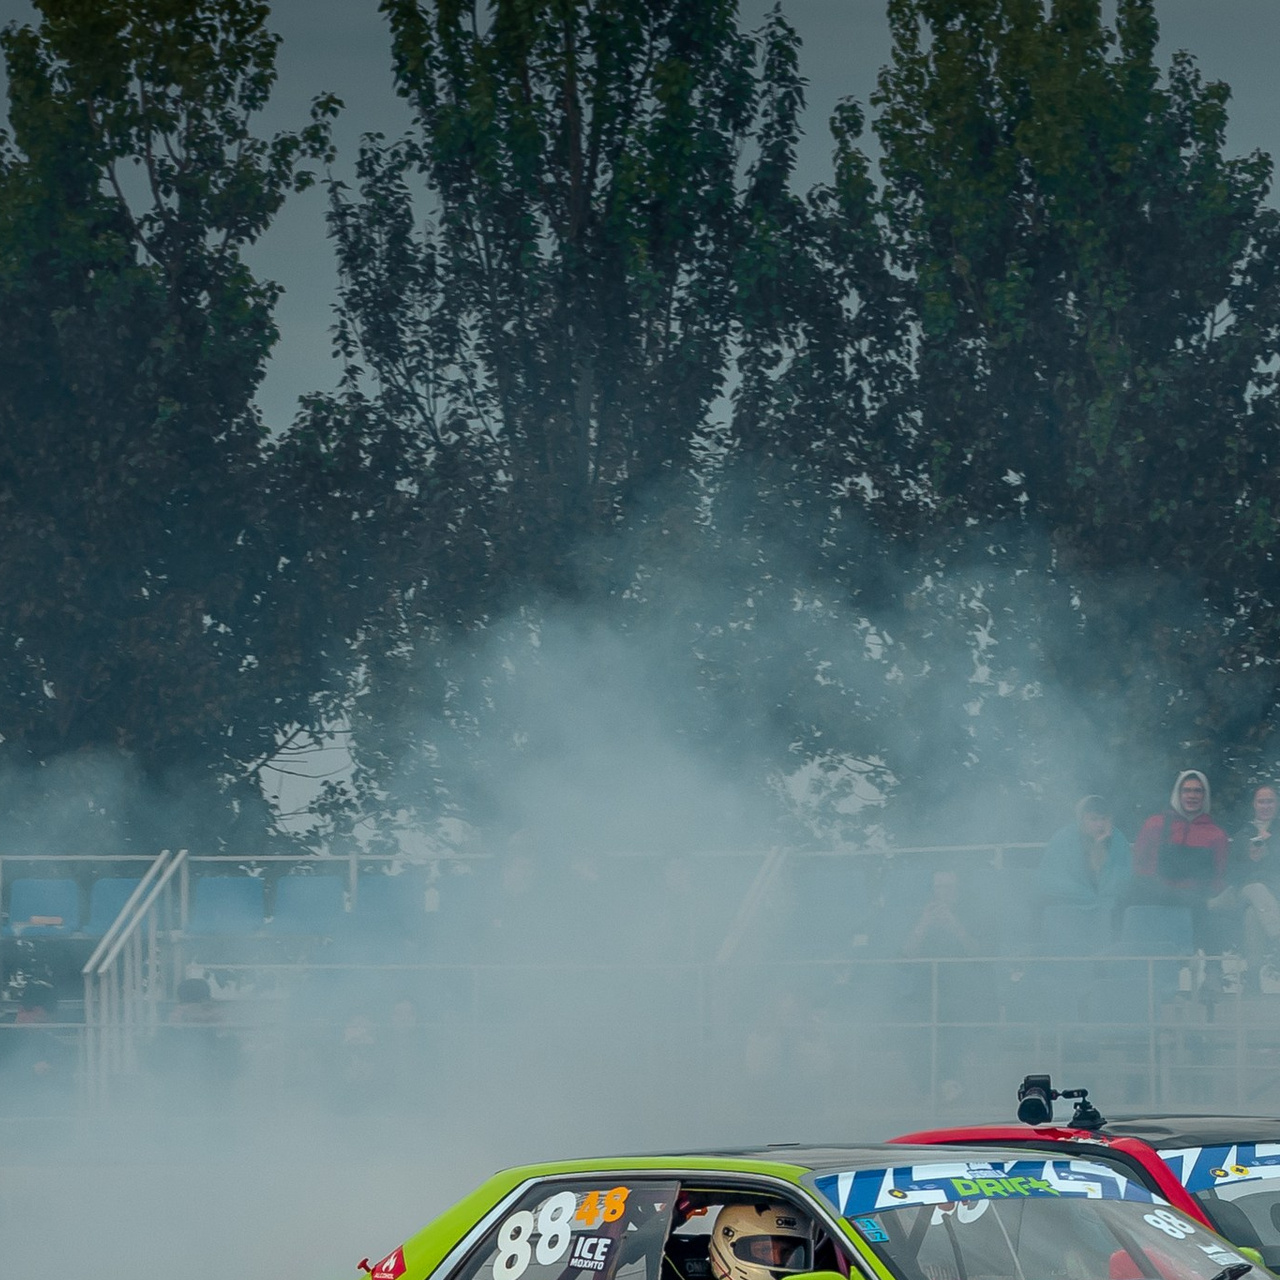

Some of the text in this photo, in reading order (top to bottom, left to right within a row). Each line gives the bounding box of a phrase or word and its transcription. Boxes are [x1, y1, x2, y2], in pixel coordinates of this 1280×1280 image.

[950, 1176, 1060, 1197] DRIFT
[575, 1187, 629, 1226] 48
[1143, 1209, 1195, 1240] 88
[574, 1236, 611, 1261] ICE
[569, 1258, 604, 1270] МОХИТО
